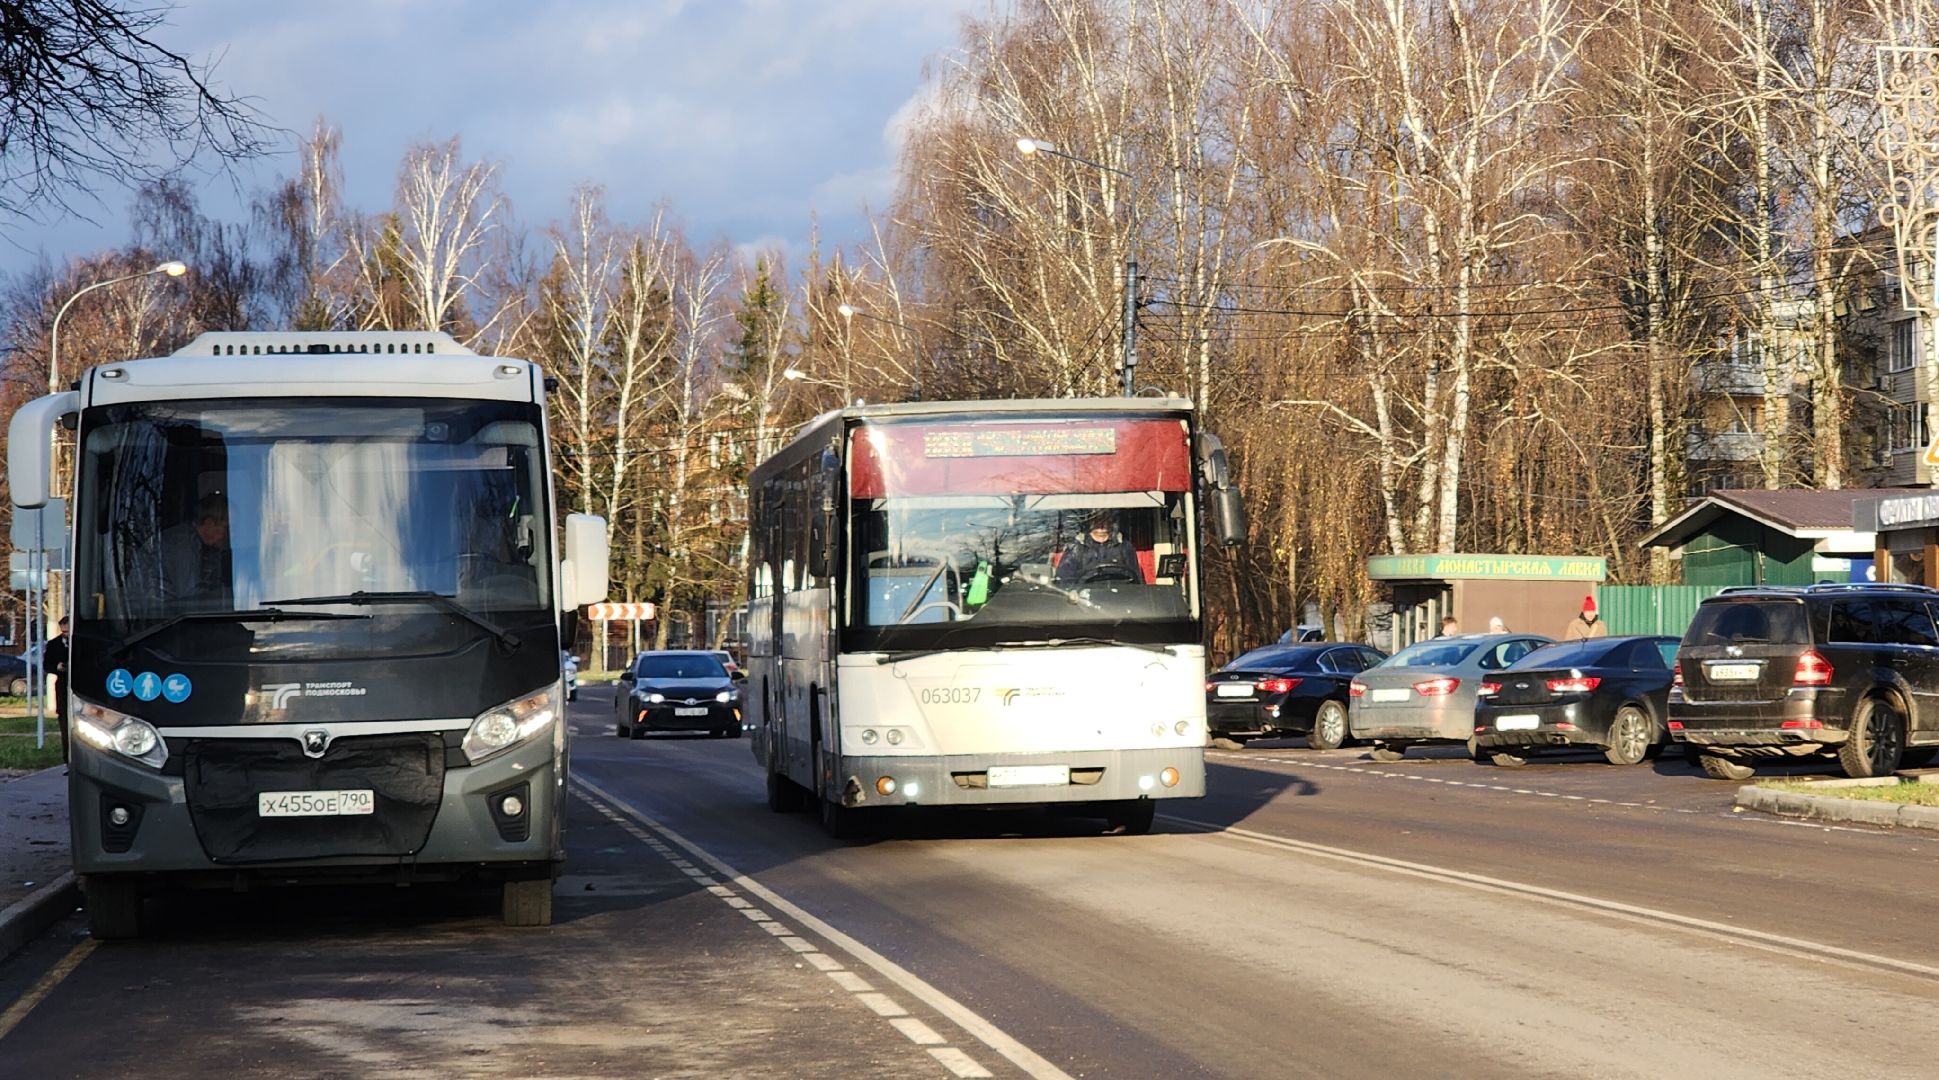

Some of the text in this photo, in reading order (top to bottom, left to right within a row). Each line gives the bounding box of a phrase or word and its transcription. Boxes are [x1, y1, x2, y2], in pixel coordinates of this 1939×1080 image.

[1435, 558, 1601, 576] МОНАСТЫРСКАЯ ЛАВКА
[921, 687, 982, 704] 063037
